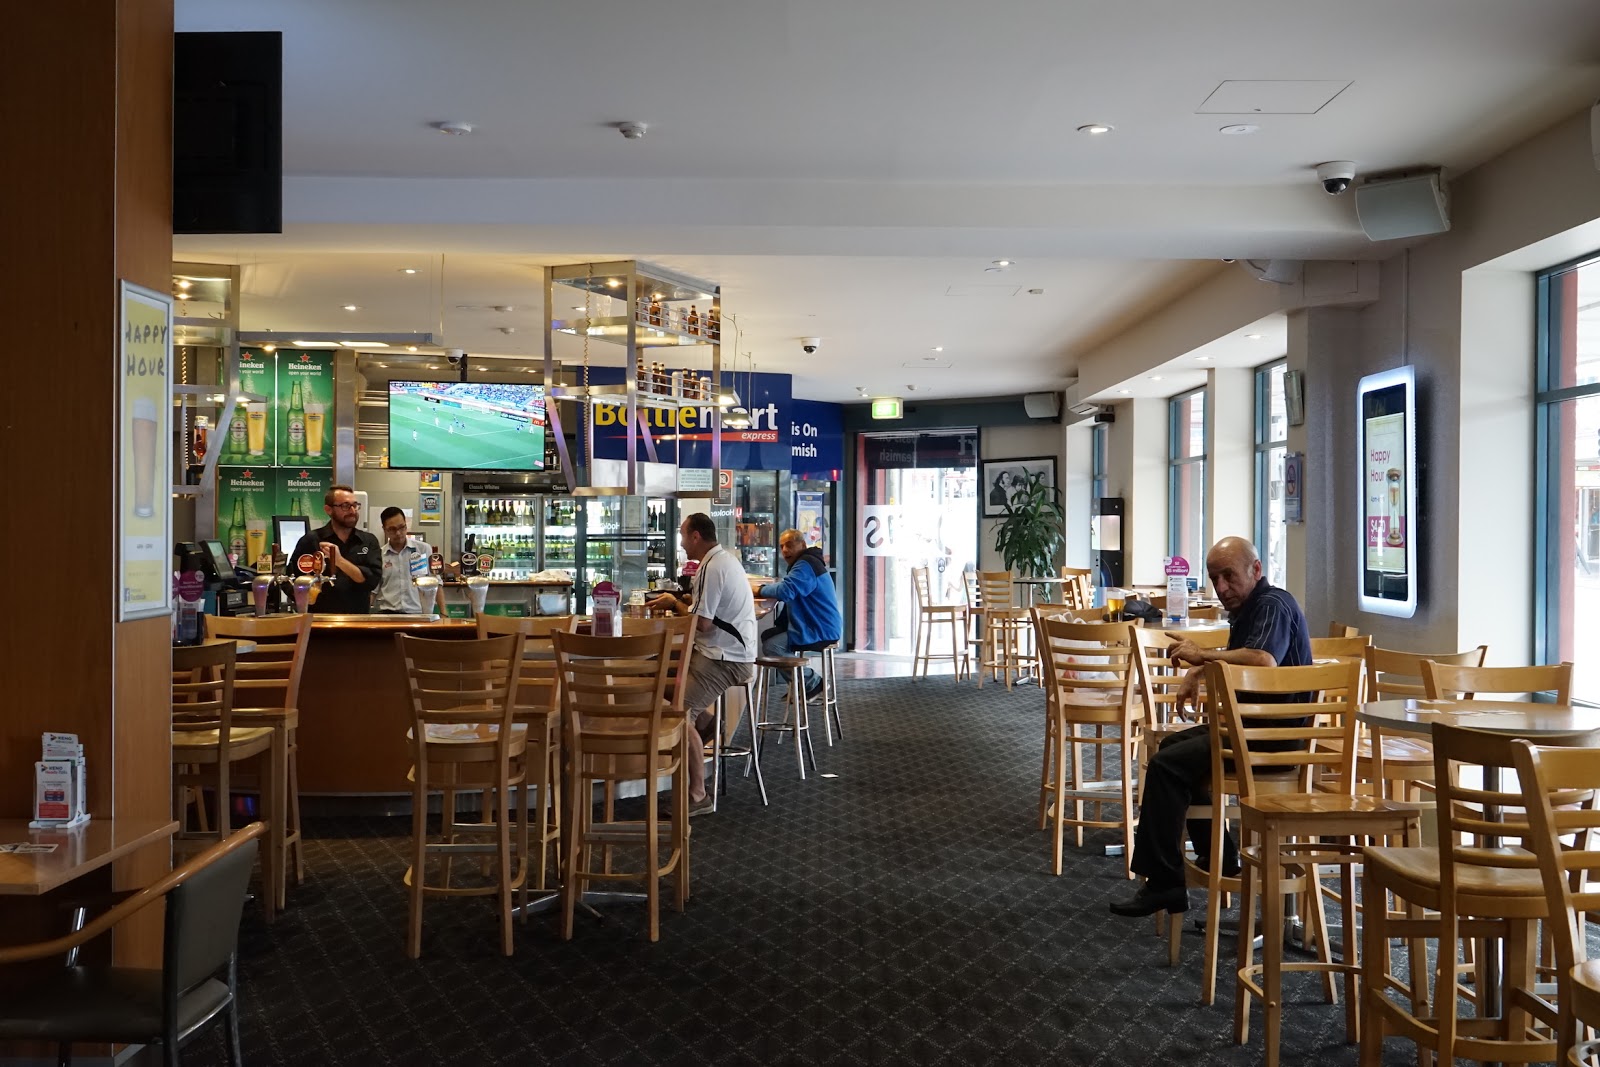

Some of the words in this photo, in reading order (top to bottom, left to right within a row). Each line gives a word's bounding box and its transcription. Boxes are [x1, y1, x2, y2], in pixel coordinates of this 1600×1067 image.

[125, 321, 167, 344] HAPPY
[127, 353, 165, 376] HOUR
[741, 432, 776, 441] express
[802, 423, 818, 437] On
[1370, 448, 1391, 465] Happy
[1370, 469, 1385, 483] Hour
